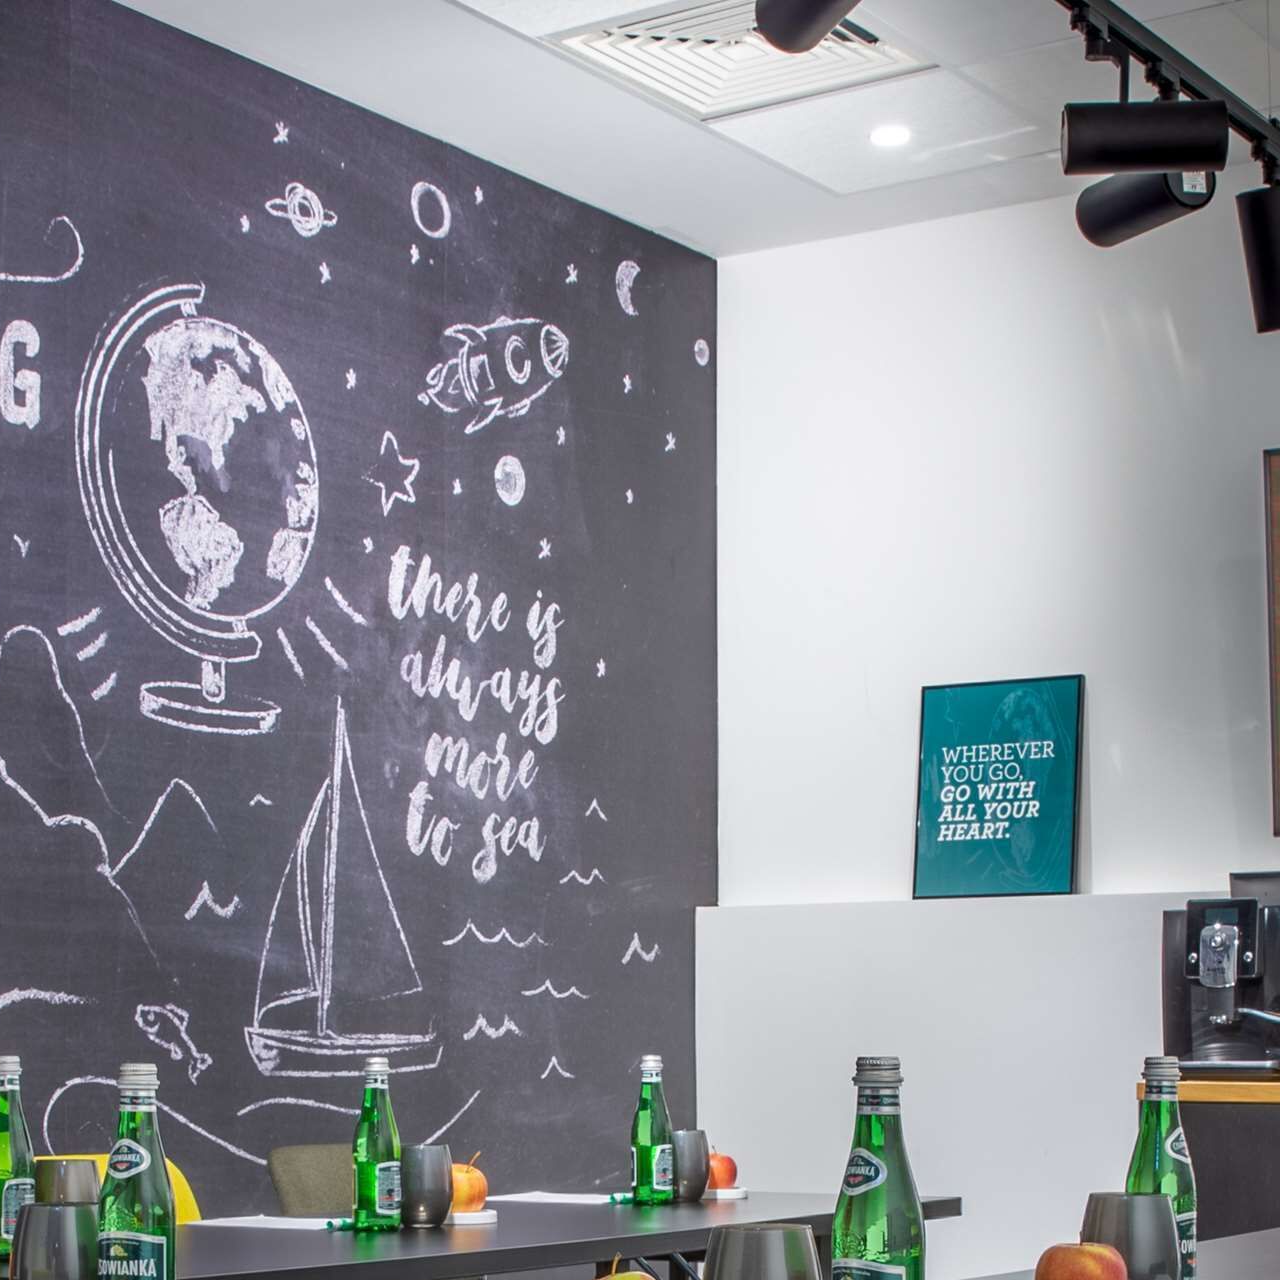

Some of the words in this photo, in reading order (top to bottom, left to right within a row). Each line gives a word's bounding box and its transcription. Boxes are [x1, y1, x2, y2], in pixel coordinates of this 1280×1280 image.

[388, 545, 511, 643] there
[526, 590, 565, 669] is
[400, 634, 565, 744] always
[942, 741, 1055, 763] WHEREVER
[425, 732, 539, 801] more
[941, 764, 984, 783] YOU
[989, 762, 1023, 781] GO,
[940, 784, 971, 802] GO
[977, 781, 1036, 800] WITH
[937, 804, 977, 822] ALL
[984, 800, 1040, 819] YOUR
[406, 781, 460, 866] to
[472, 813, 547, 884] sea
[937, 822, 1010, 841] HEART.
